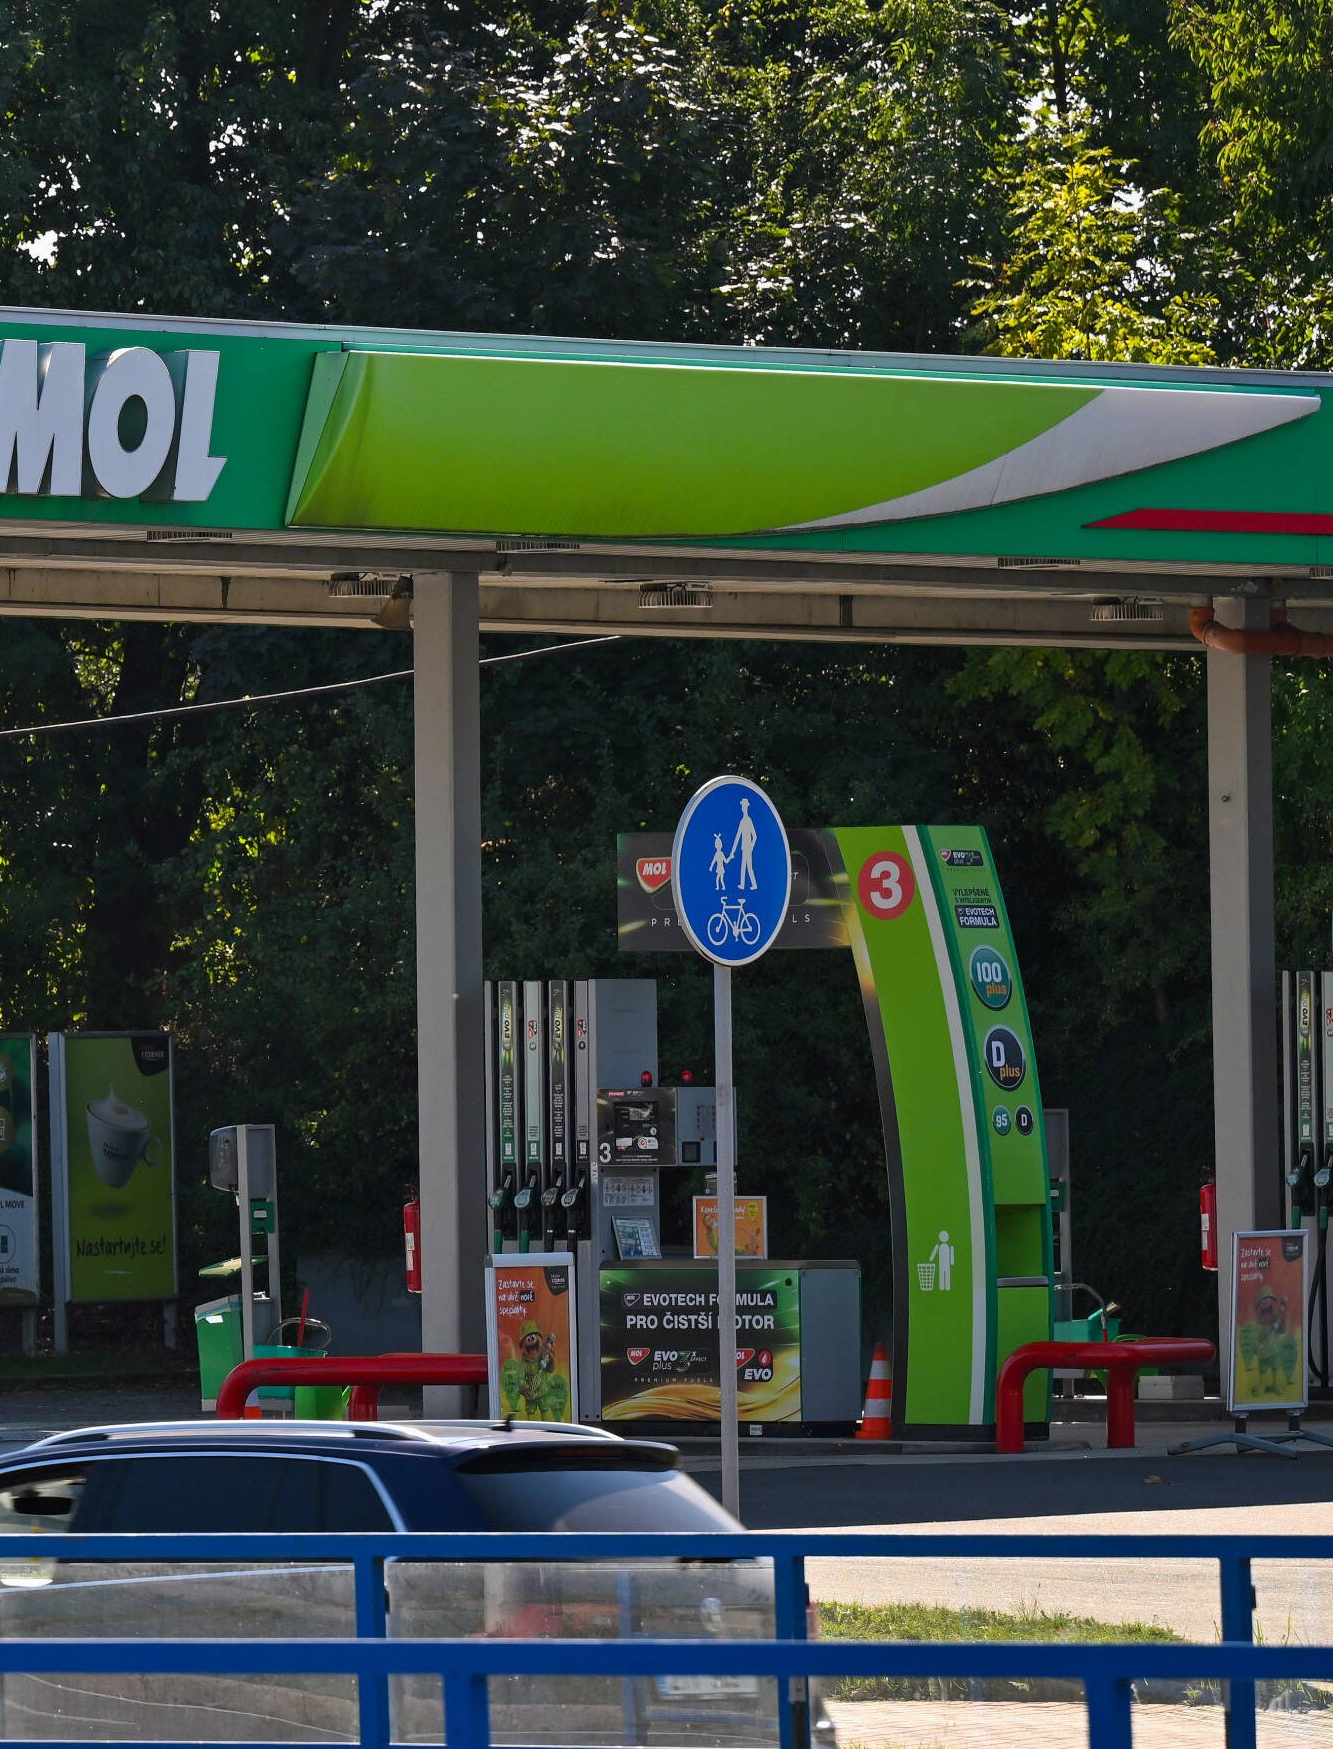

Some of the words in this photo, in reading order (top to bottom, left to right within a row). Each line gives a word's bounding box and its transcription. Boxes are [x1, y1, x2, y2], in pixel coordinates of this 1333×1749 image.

[642, 862, 668, 876] MOL
[869, 861, 904, 910] 3
[965, 907, 995, 916] EVOTECH
[960, 917, 997, 926] FORMULA
[976, 961, 1002, 983] 100
[986, 983, 1008, 998] plus
[991, 1040, 1005, 1068] D
[999, 1064, 1021, 1080] plus
[995, 1112, 1009, 1127] 95
[1020, 1113, 1028, 1127] D
[599, 1142, 612, 1163] 3
[5, 1200, 25, 1209] MOVE
[76, 1237, 146, 1259] Nastartujte
[150, 1236, 166, 1257] se!
[643, 1293, 705, 1306] EVOTECH
[709, 1293, 774, 1306] FMULA
[626, 1315, 658, 1329] PRO
[663, 1311, 713, 1330] ČISTŠÍ
[654, 1350, 678, 1362] EVO
[652, 1360, 672, 1371] plus
[744, 1368, 772, 1380] EVO
